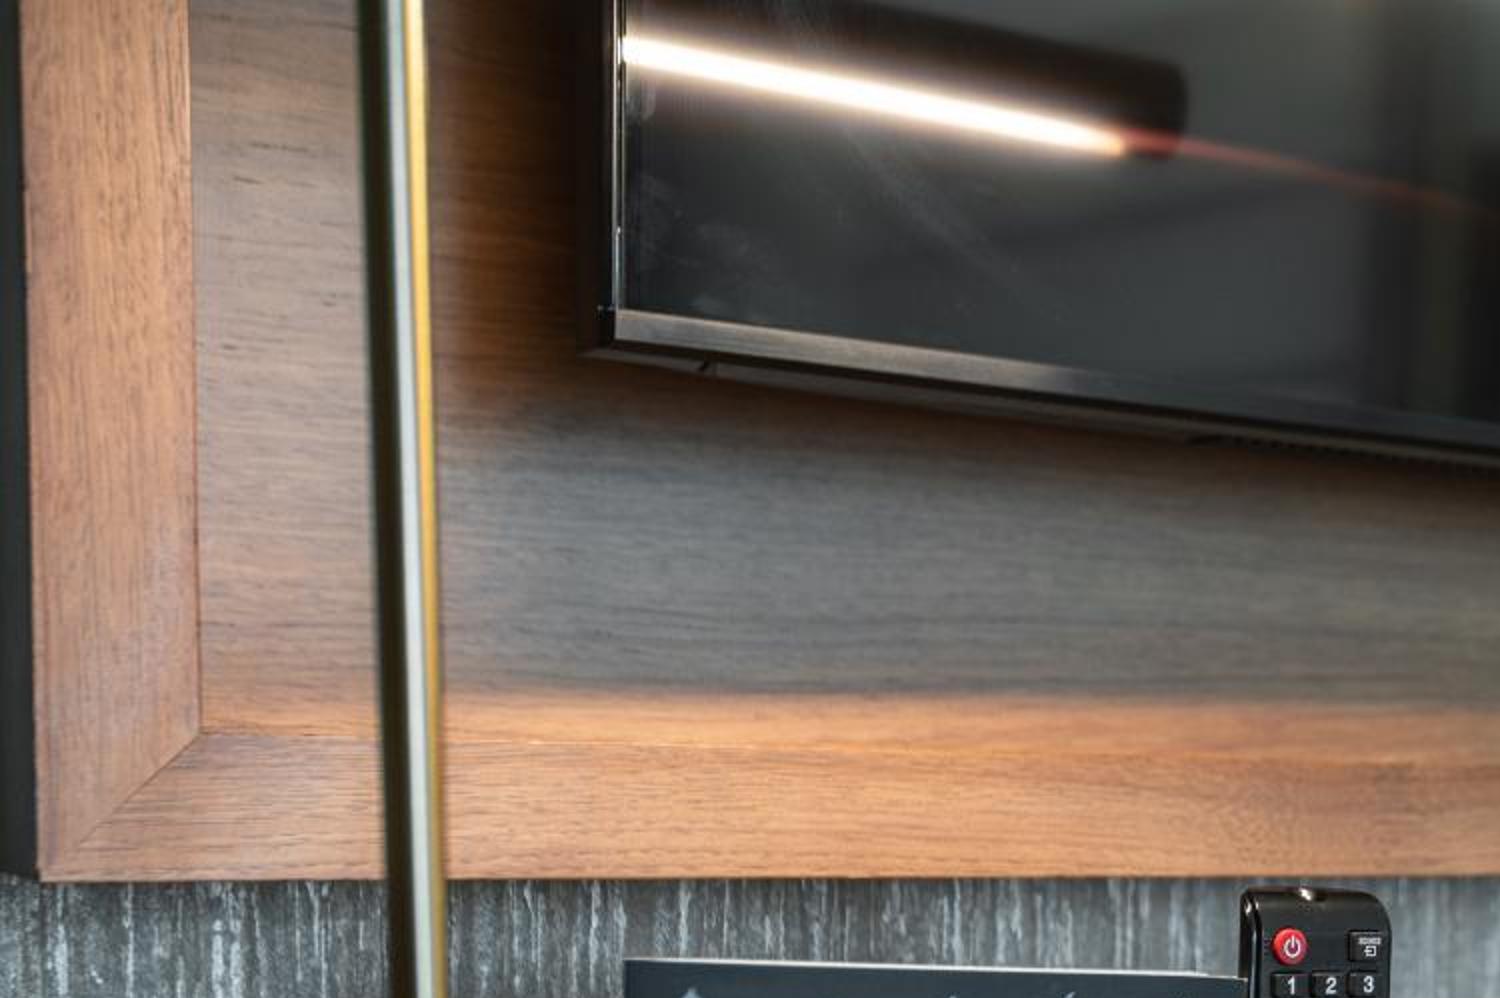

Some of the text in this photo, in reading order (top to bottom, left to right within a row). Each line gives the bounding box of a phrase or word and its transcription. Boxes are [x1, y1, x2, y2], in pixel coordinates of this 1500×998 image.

[1287, 975, 1296, 995] 1
[1325, 976, 1337, 995] 2
[1363, 975, 1375, 993] 3
